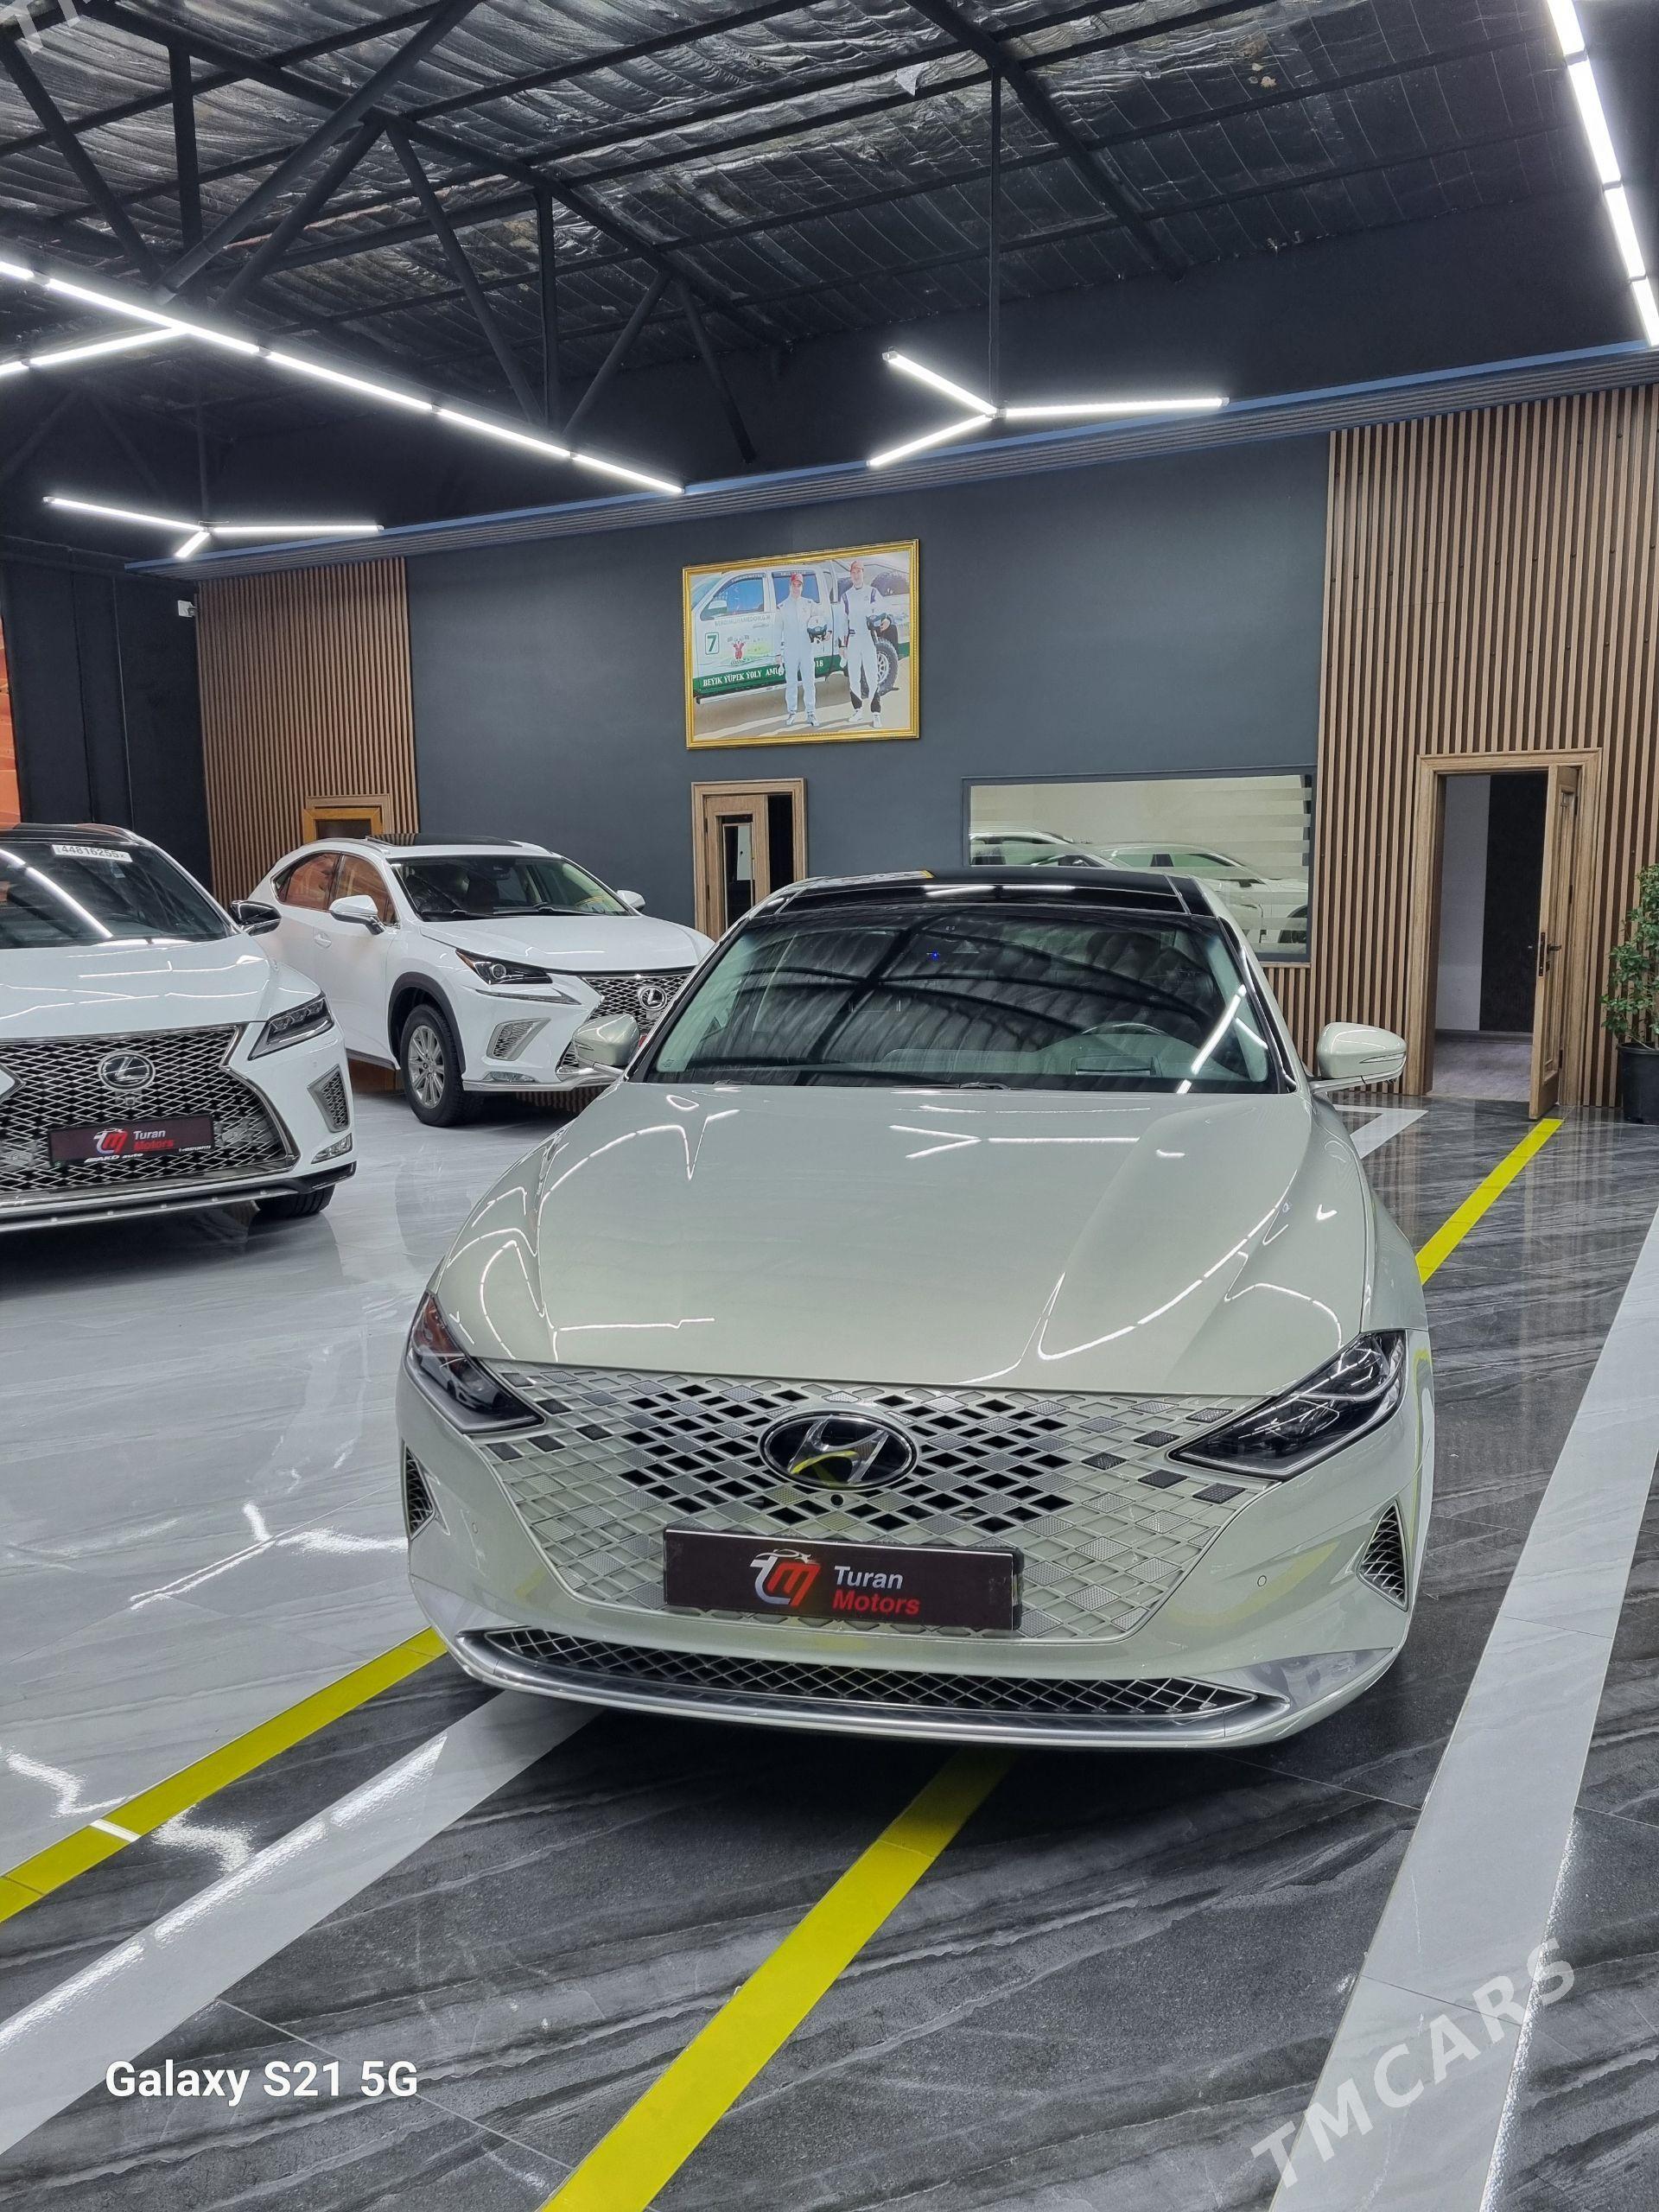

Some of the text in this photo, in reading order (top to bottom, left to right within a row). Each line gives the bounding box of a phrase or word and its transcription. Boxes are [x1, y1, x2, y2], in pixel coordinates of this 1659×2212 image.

[707, 634, 717, 652] 7
[133, 1130, 166, 1141] Turan
[133, 1140, 174, 1152] Motors
[834, 1565, 904, 1590] Turan
[832, 1589, 920, 1615] Motors
